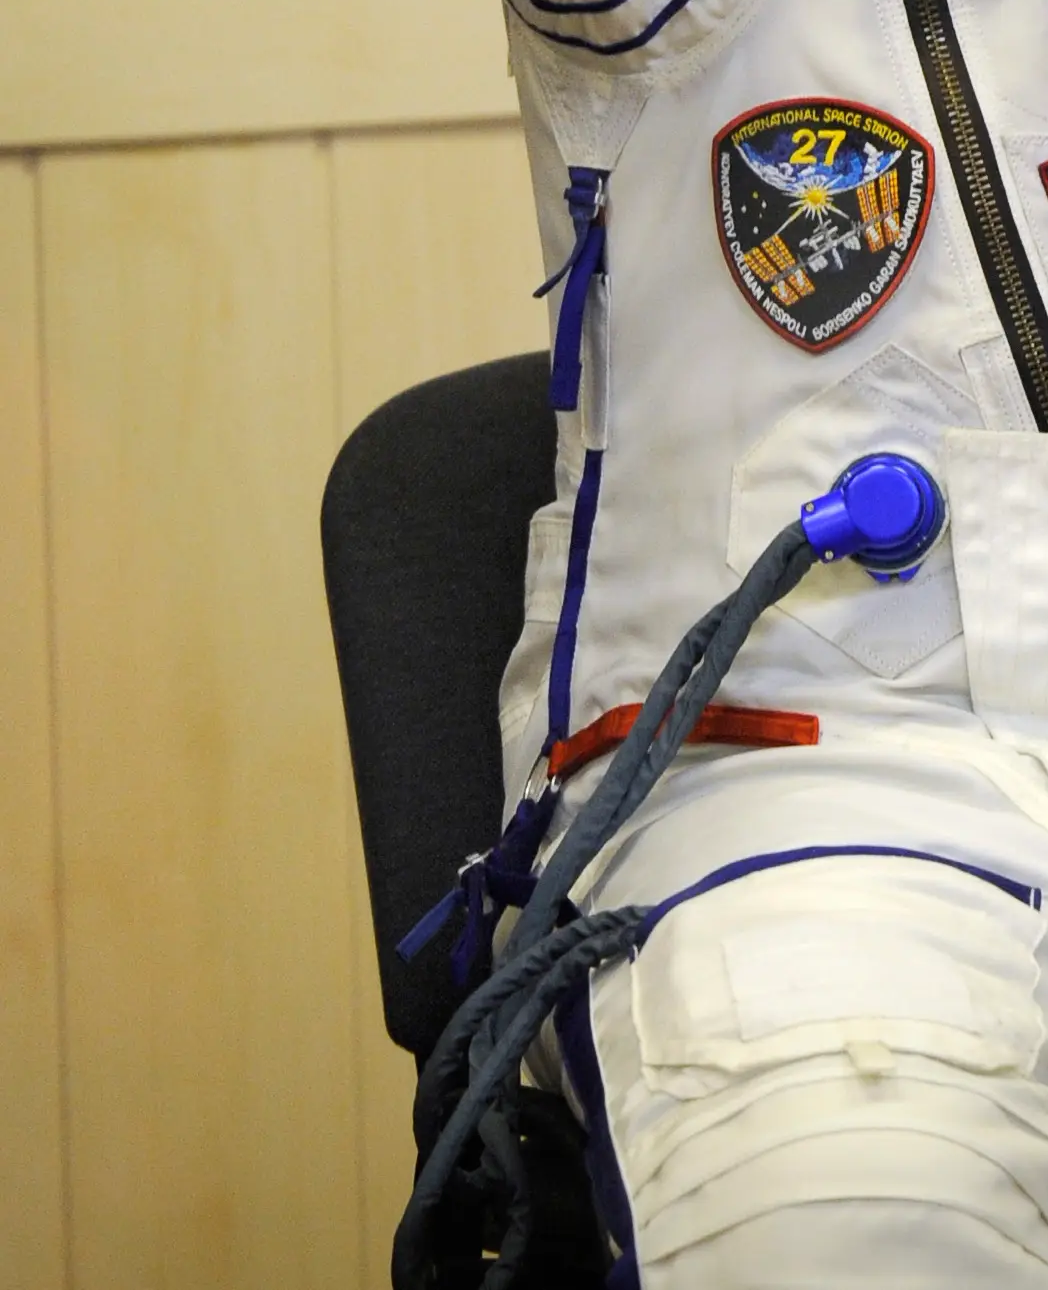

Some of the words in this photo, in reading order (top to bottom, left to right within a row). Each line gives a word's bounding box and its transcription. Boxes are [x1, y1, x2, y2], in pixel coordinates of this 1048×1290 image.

[731, 108, 820, 146] INTERNATIONAL
[823, 108, 862, 128] SPACE
[862, 118, 908, 150] STATION
[789, 128, 847, 167] 27
[730, 241, 764, 301] COLEMAN
[762, 296, 807, 338] NESPOLI
[812, 292, 872, 341] BORISENKO
[869, 250, 901, 294] GARAN
